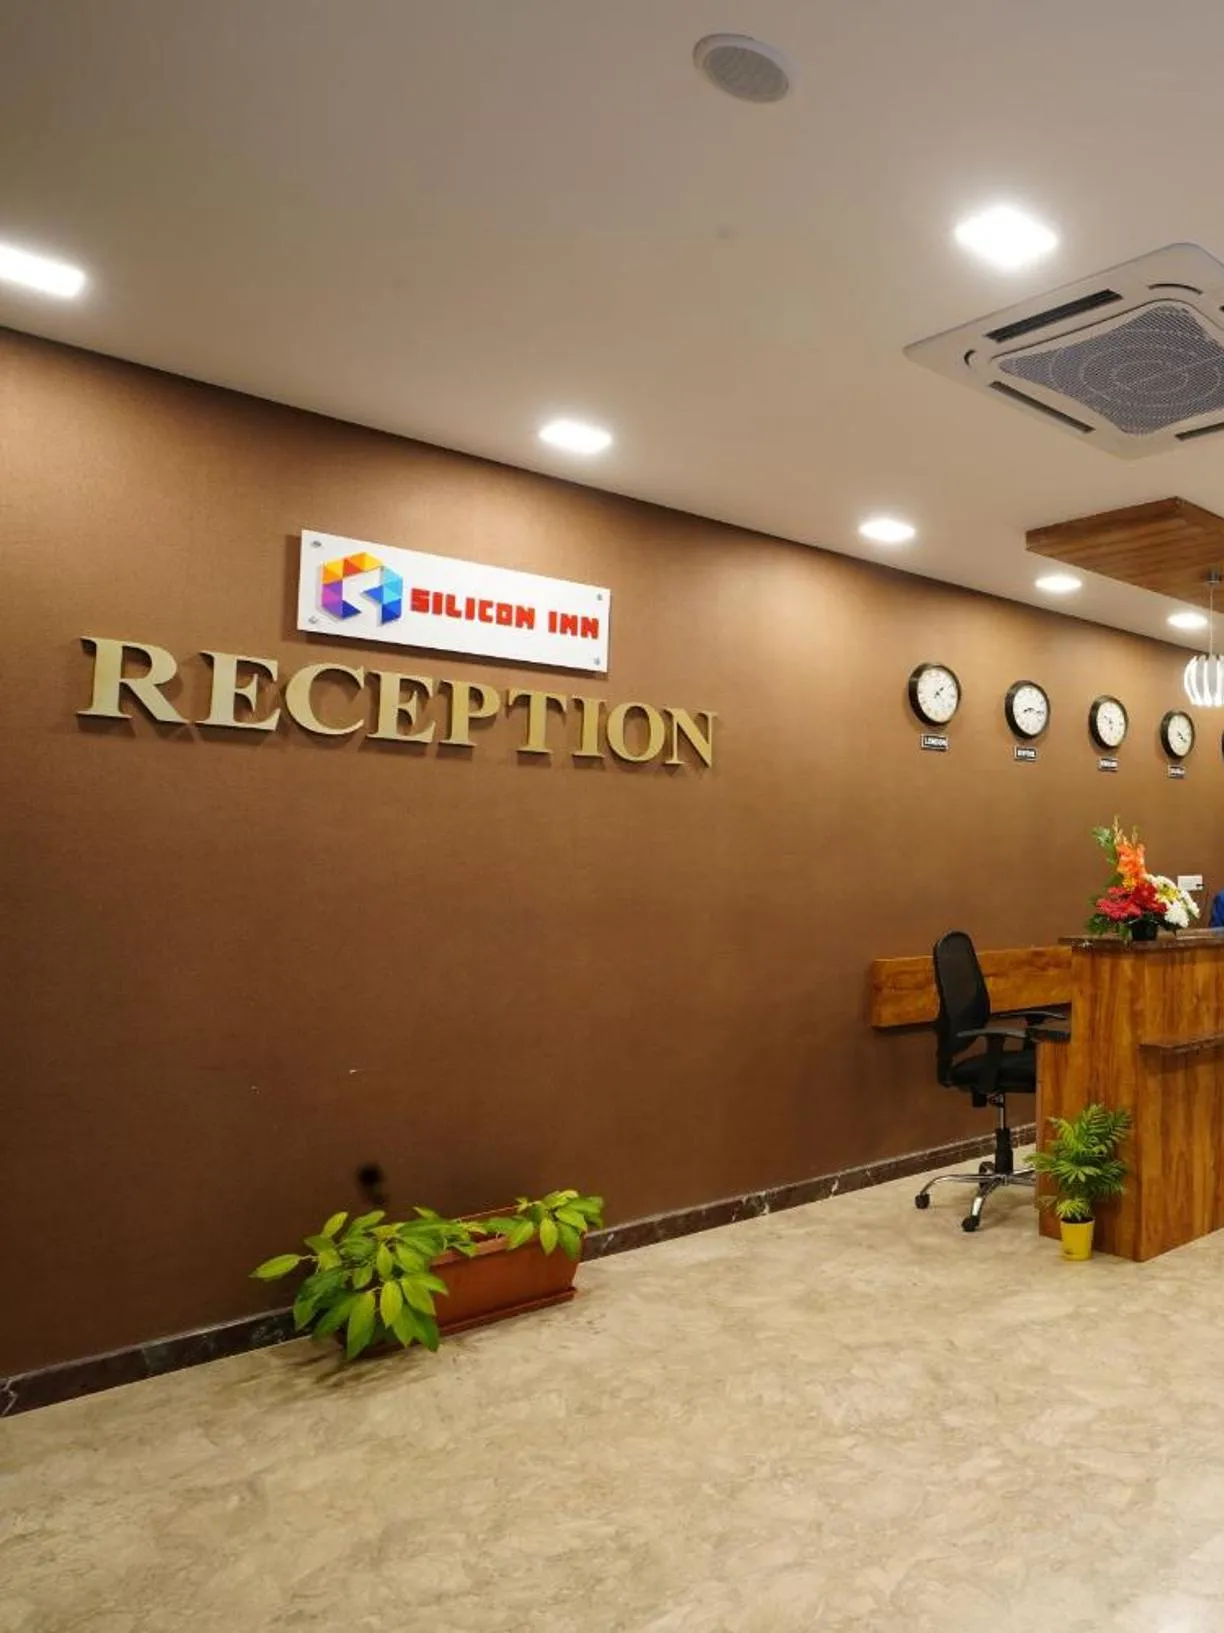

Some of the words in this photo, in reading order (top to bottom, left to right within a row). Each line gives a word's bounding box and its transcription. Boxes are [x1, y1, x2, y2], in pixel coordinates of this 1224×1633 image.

[410, 587, 536, 630] SILICON
[547, 610, 600, 640] INN
[76, 635, 718, 768] RECEPTION
